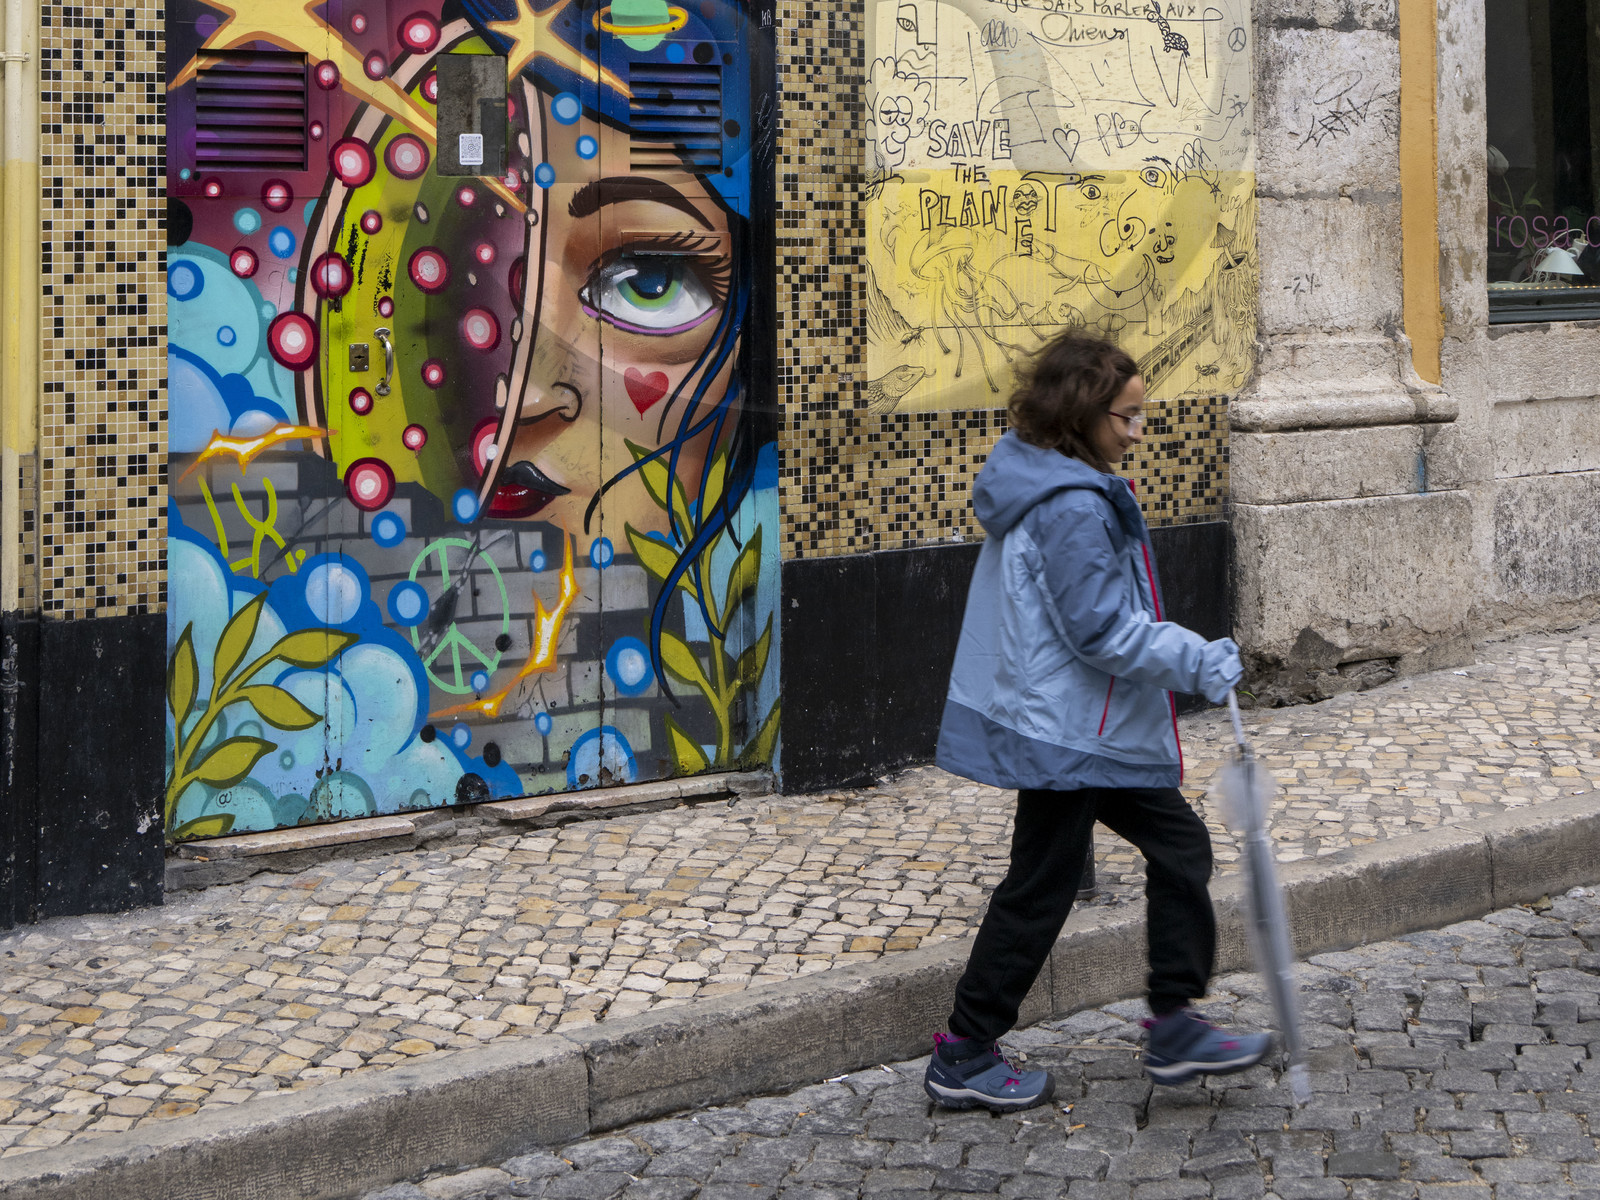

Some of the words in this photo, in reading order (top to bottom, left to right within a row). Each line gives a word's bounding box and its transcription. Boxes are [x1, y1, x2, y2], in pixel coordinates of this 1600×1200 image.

[1166, 2, 1196, 18] AUX
[927, 119, 1013, 160] SAVE
[950, 162, 987, 183] THE
[1495, 215, 1572, 248] rosa
